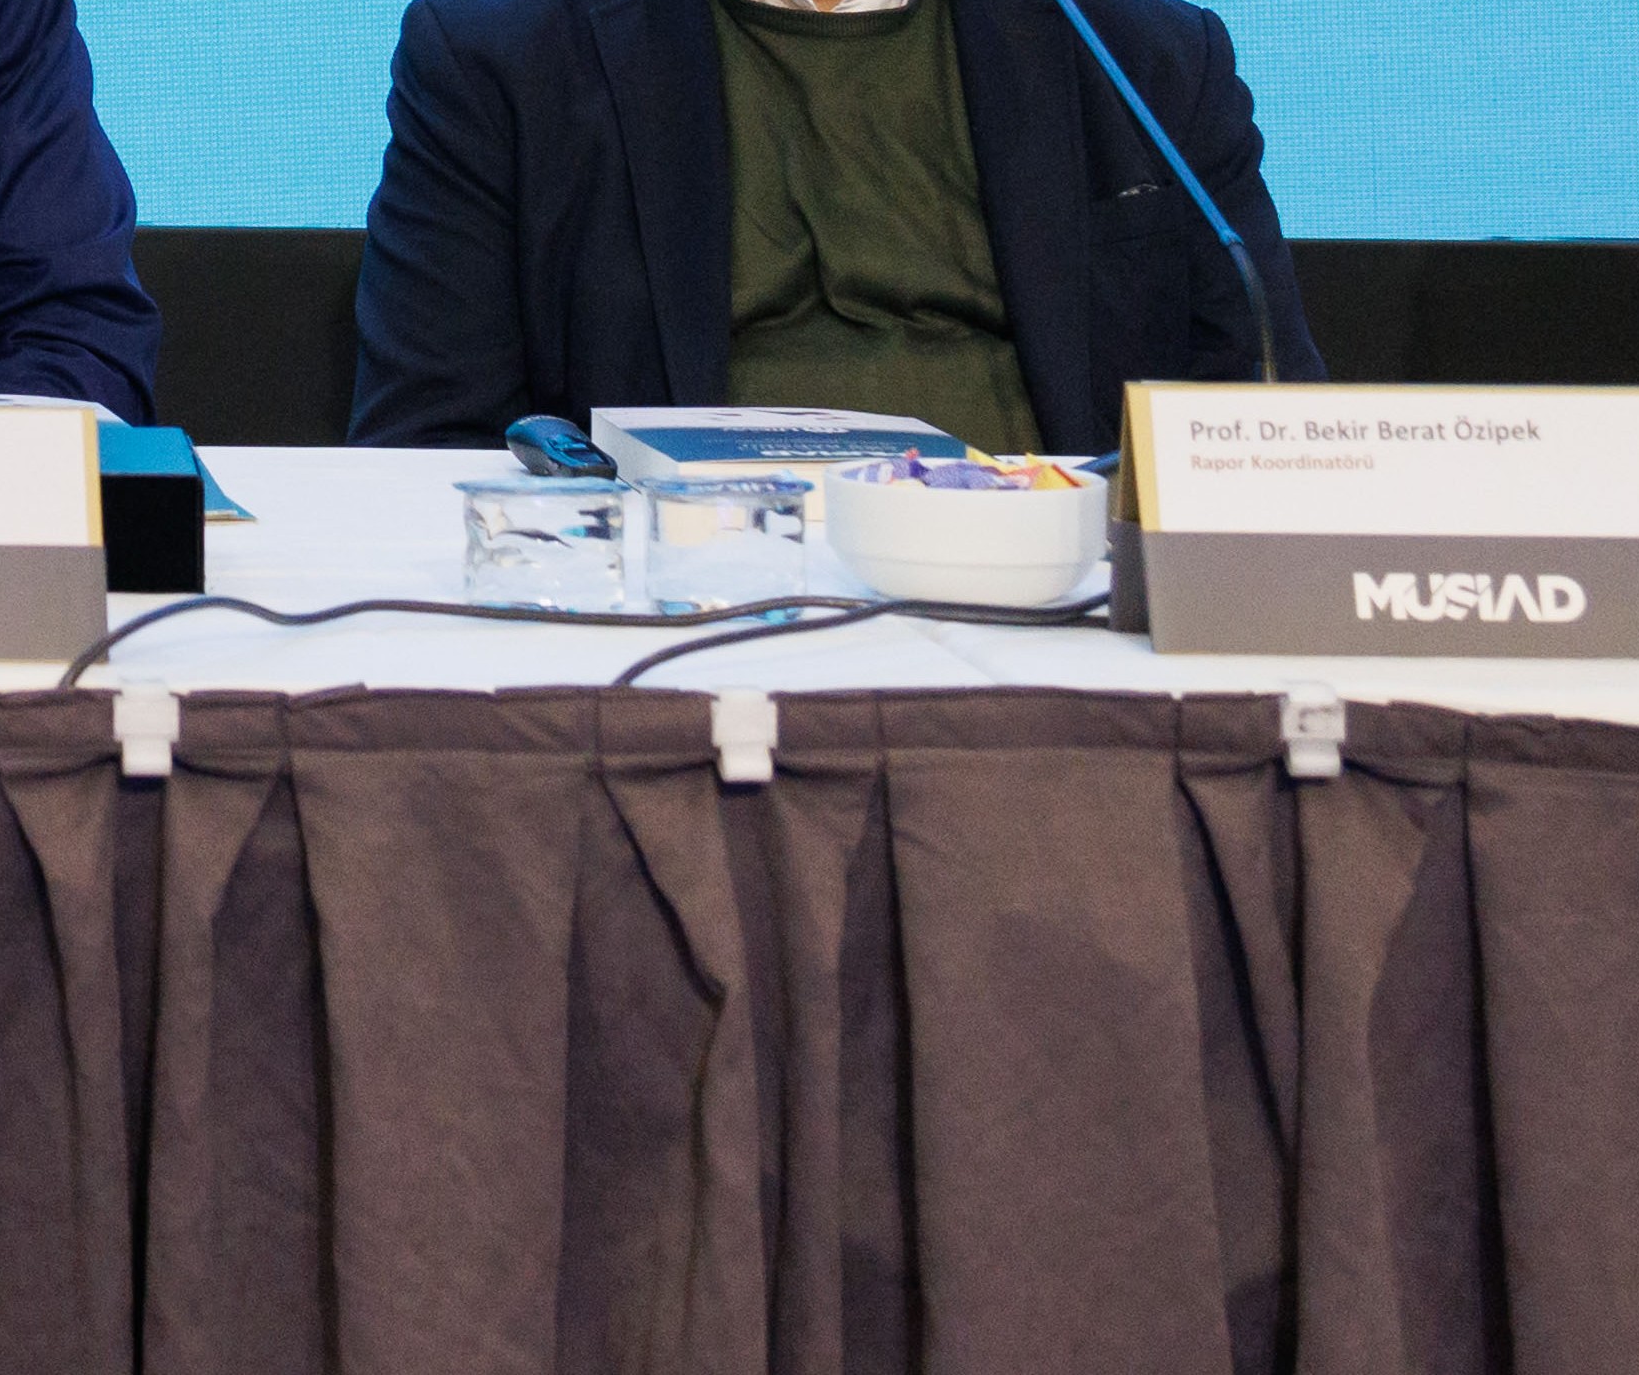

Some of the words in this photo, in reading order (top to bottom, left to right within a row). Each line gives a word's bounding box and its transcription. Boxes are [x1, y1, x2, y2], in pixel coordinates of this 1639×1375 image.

[1190, 421, 1250, 440] Prof.
[1259, 422, 1296, 441] Dr.
[1304, 420, 1368, 441] Bekir
[1378, 422, 1447, 441] Berat
[1454, 417, 1542, 445] Özipek
[1190, 455, 1244, 472] Rapor
[1251, 453, 1375, 471] Koordinatörü
